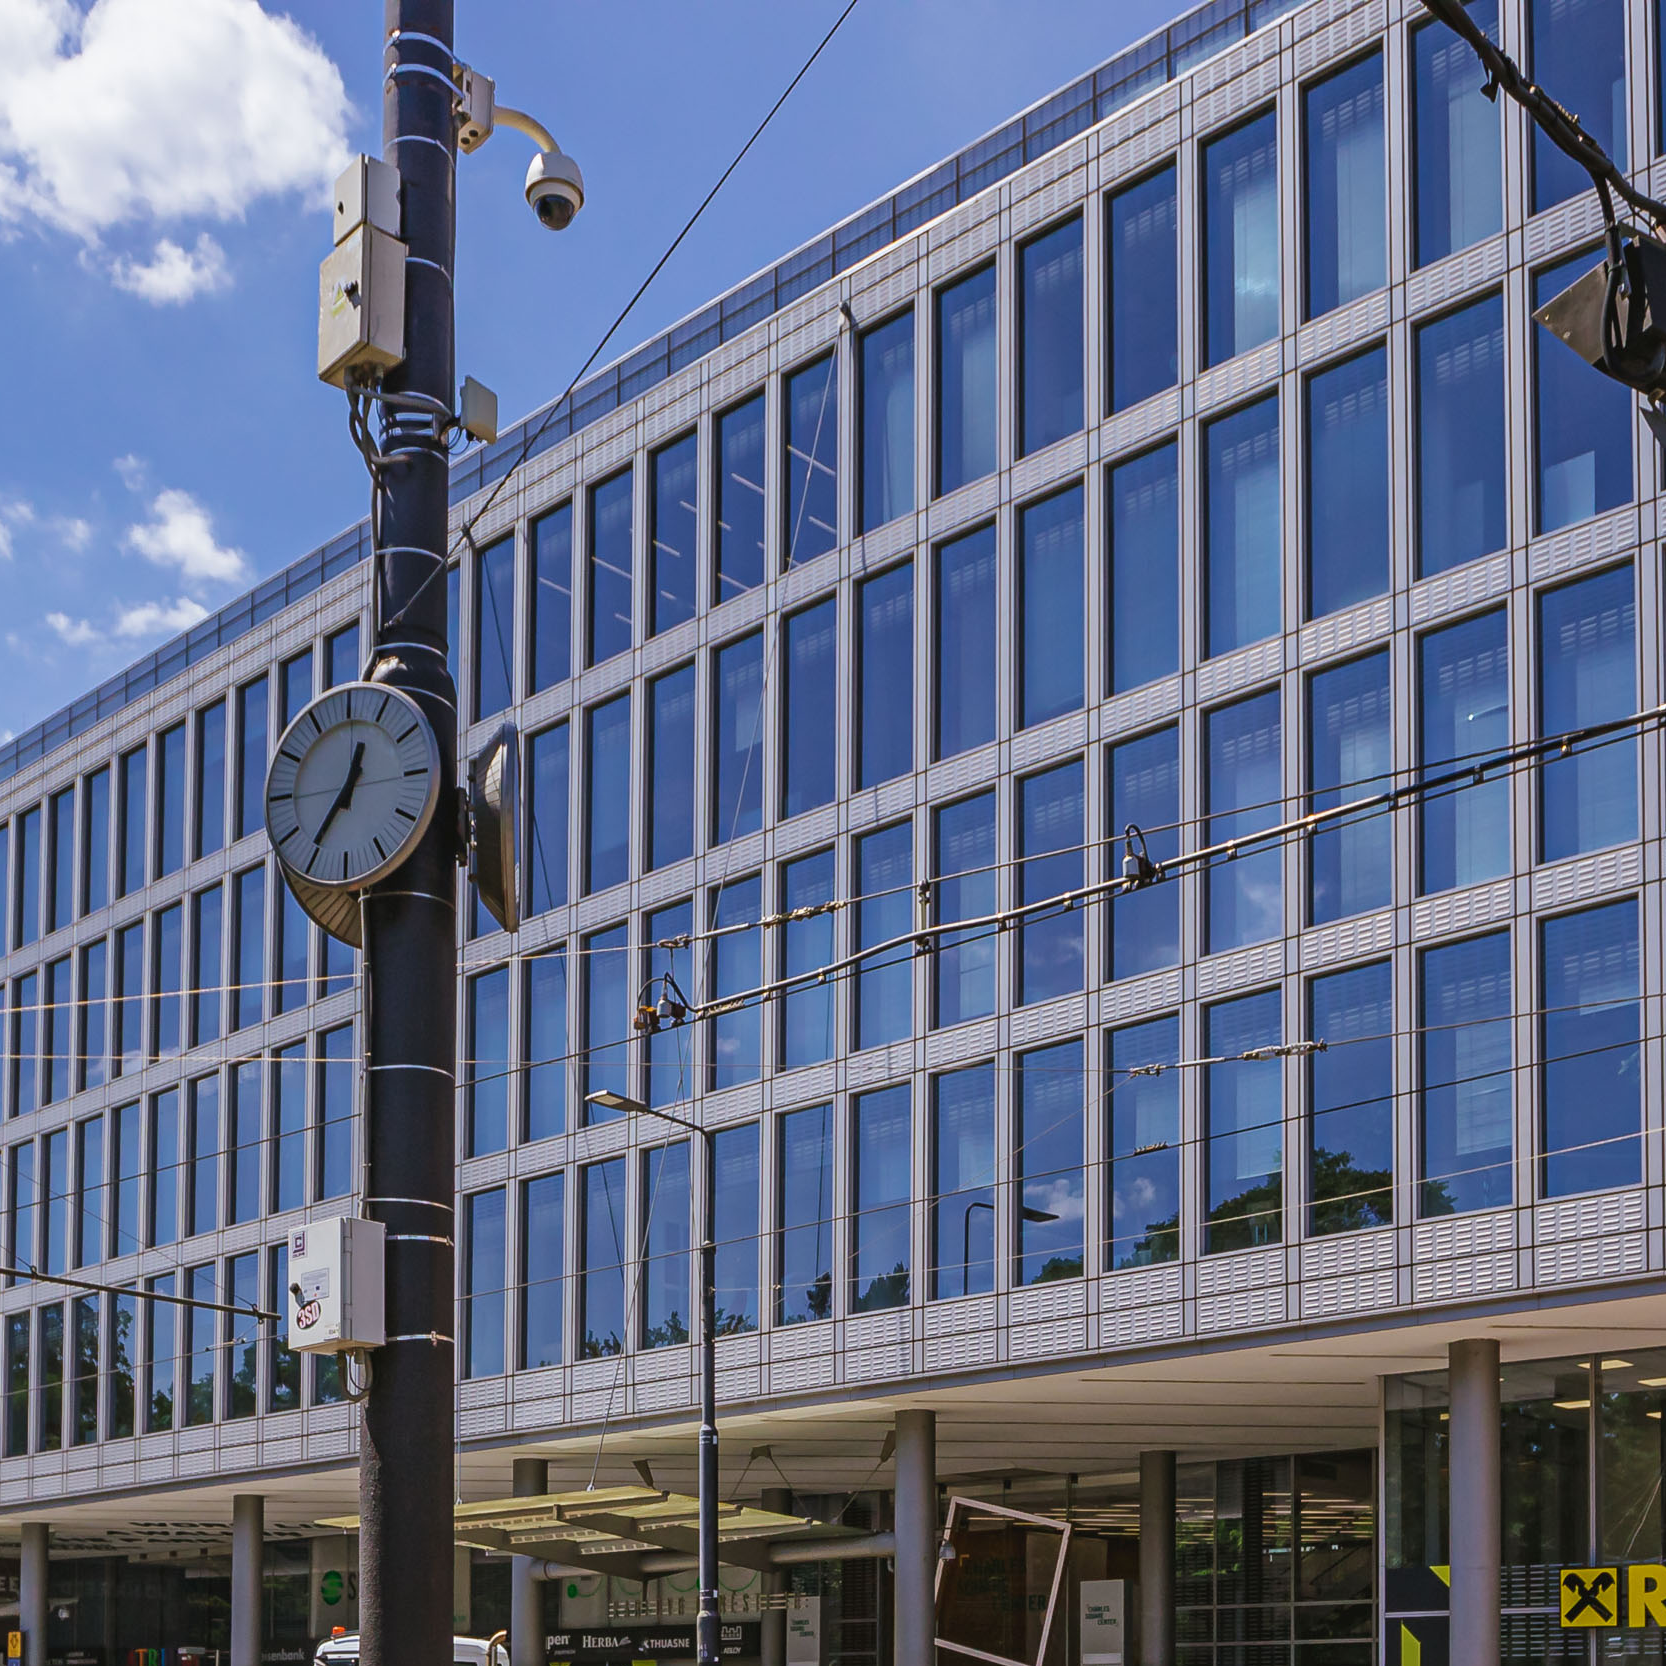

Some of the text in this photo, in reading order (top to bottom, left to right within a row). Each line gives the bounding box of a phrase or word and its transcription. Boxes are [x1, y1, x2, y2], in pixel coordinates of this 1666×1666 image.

[298, 1302, 321, 1329] 3SD
[582, 1635, 619, 1649] HERBA
[649, 1638, 691, 1649] THUASNE
